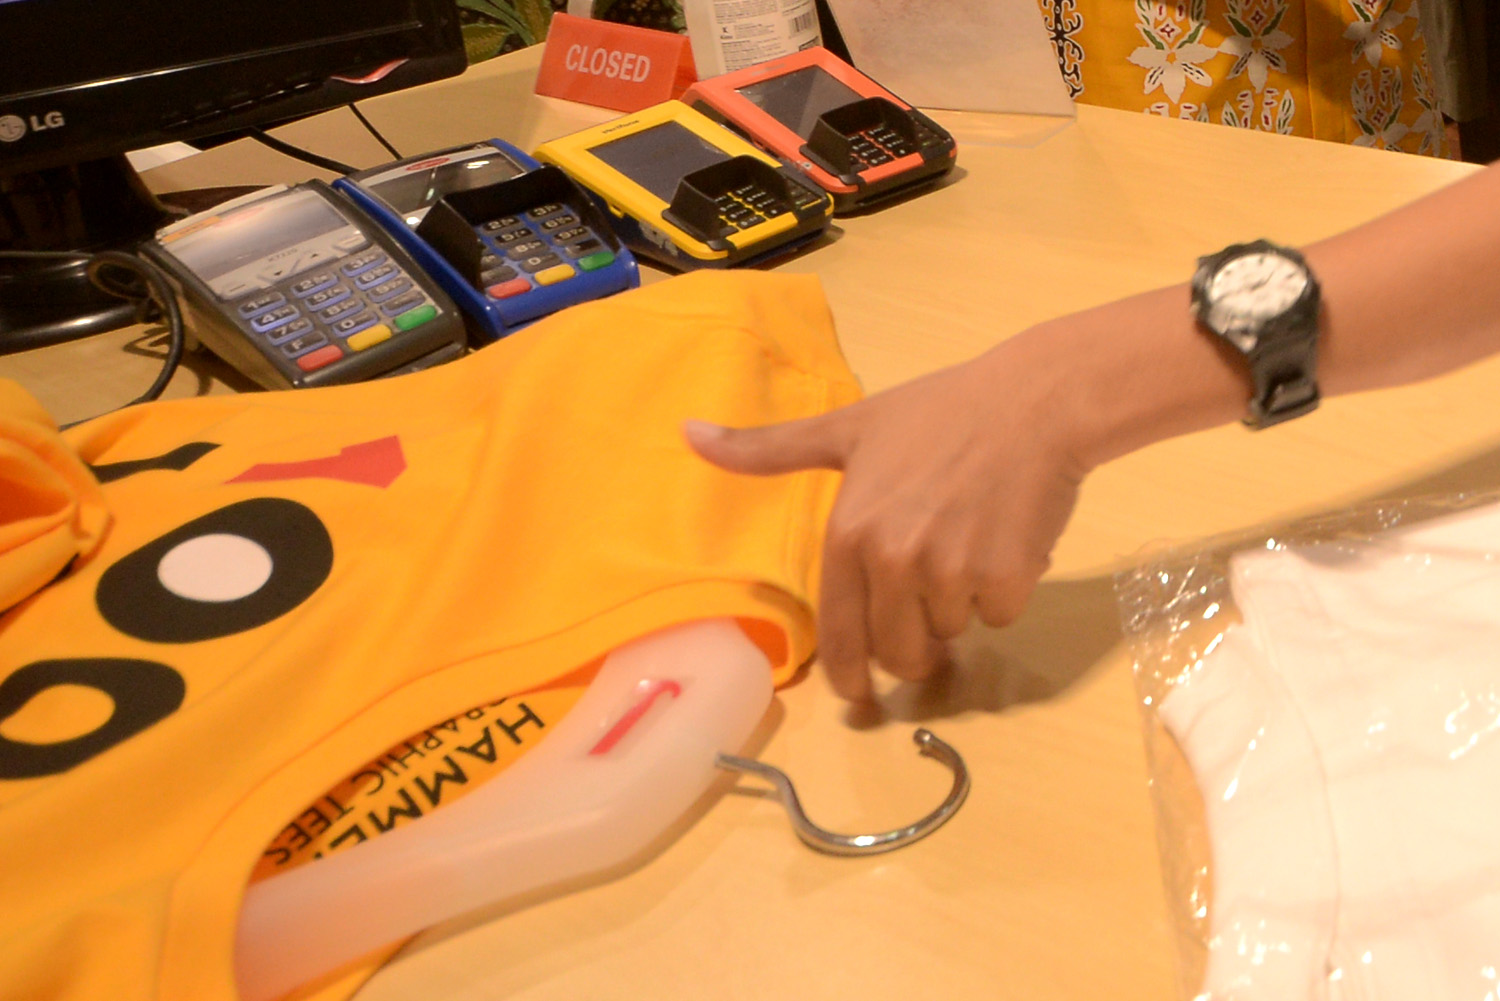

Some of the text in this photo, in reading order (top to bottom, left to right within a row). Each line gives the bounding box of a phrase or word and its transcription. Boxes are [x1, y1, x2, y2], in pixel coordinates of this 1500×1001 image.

[565, 44, 651, 83] CLOSED
[30, 111, 65, 132] LG
[312, 702, 546, 861] HAMME
[263, 795, 354, 867] TEES
